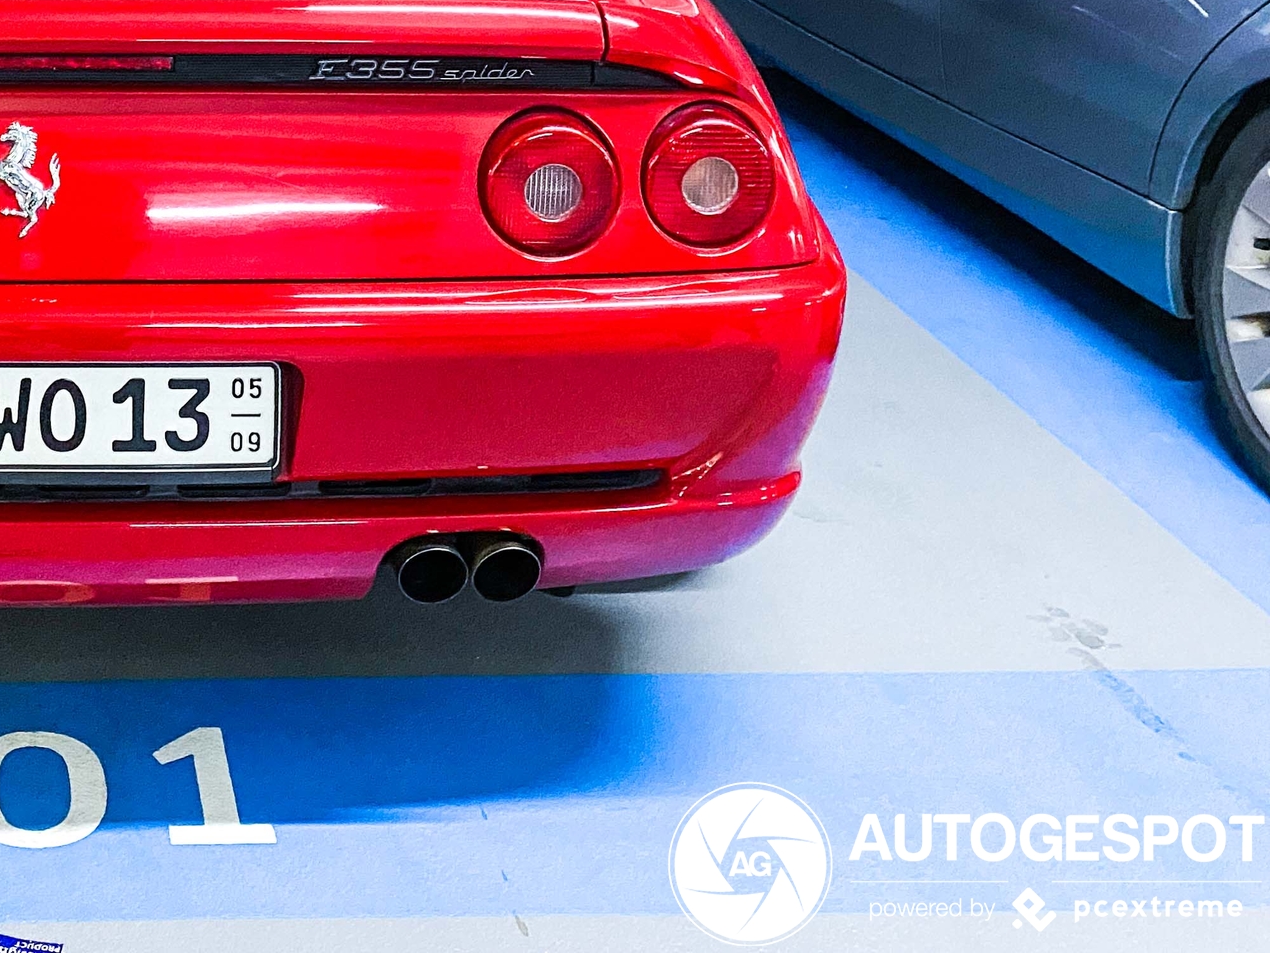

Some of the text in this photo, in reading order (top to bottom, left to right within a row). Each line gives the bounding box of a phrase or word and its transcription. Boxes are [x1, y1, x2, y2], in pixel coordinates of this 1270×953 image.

[309, 58, 535, 82] F355 spider
[231, 377, 262, 398] 05
[112, 378, 210, 452] 13
[230, 431, 261, 452] 09
